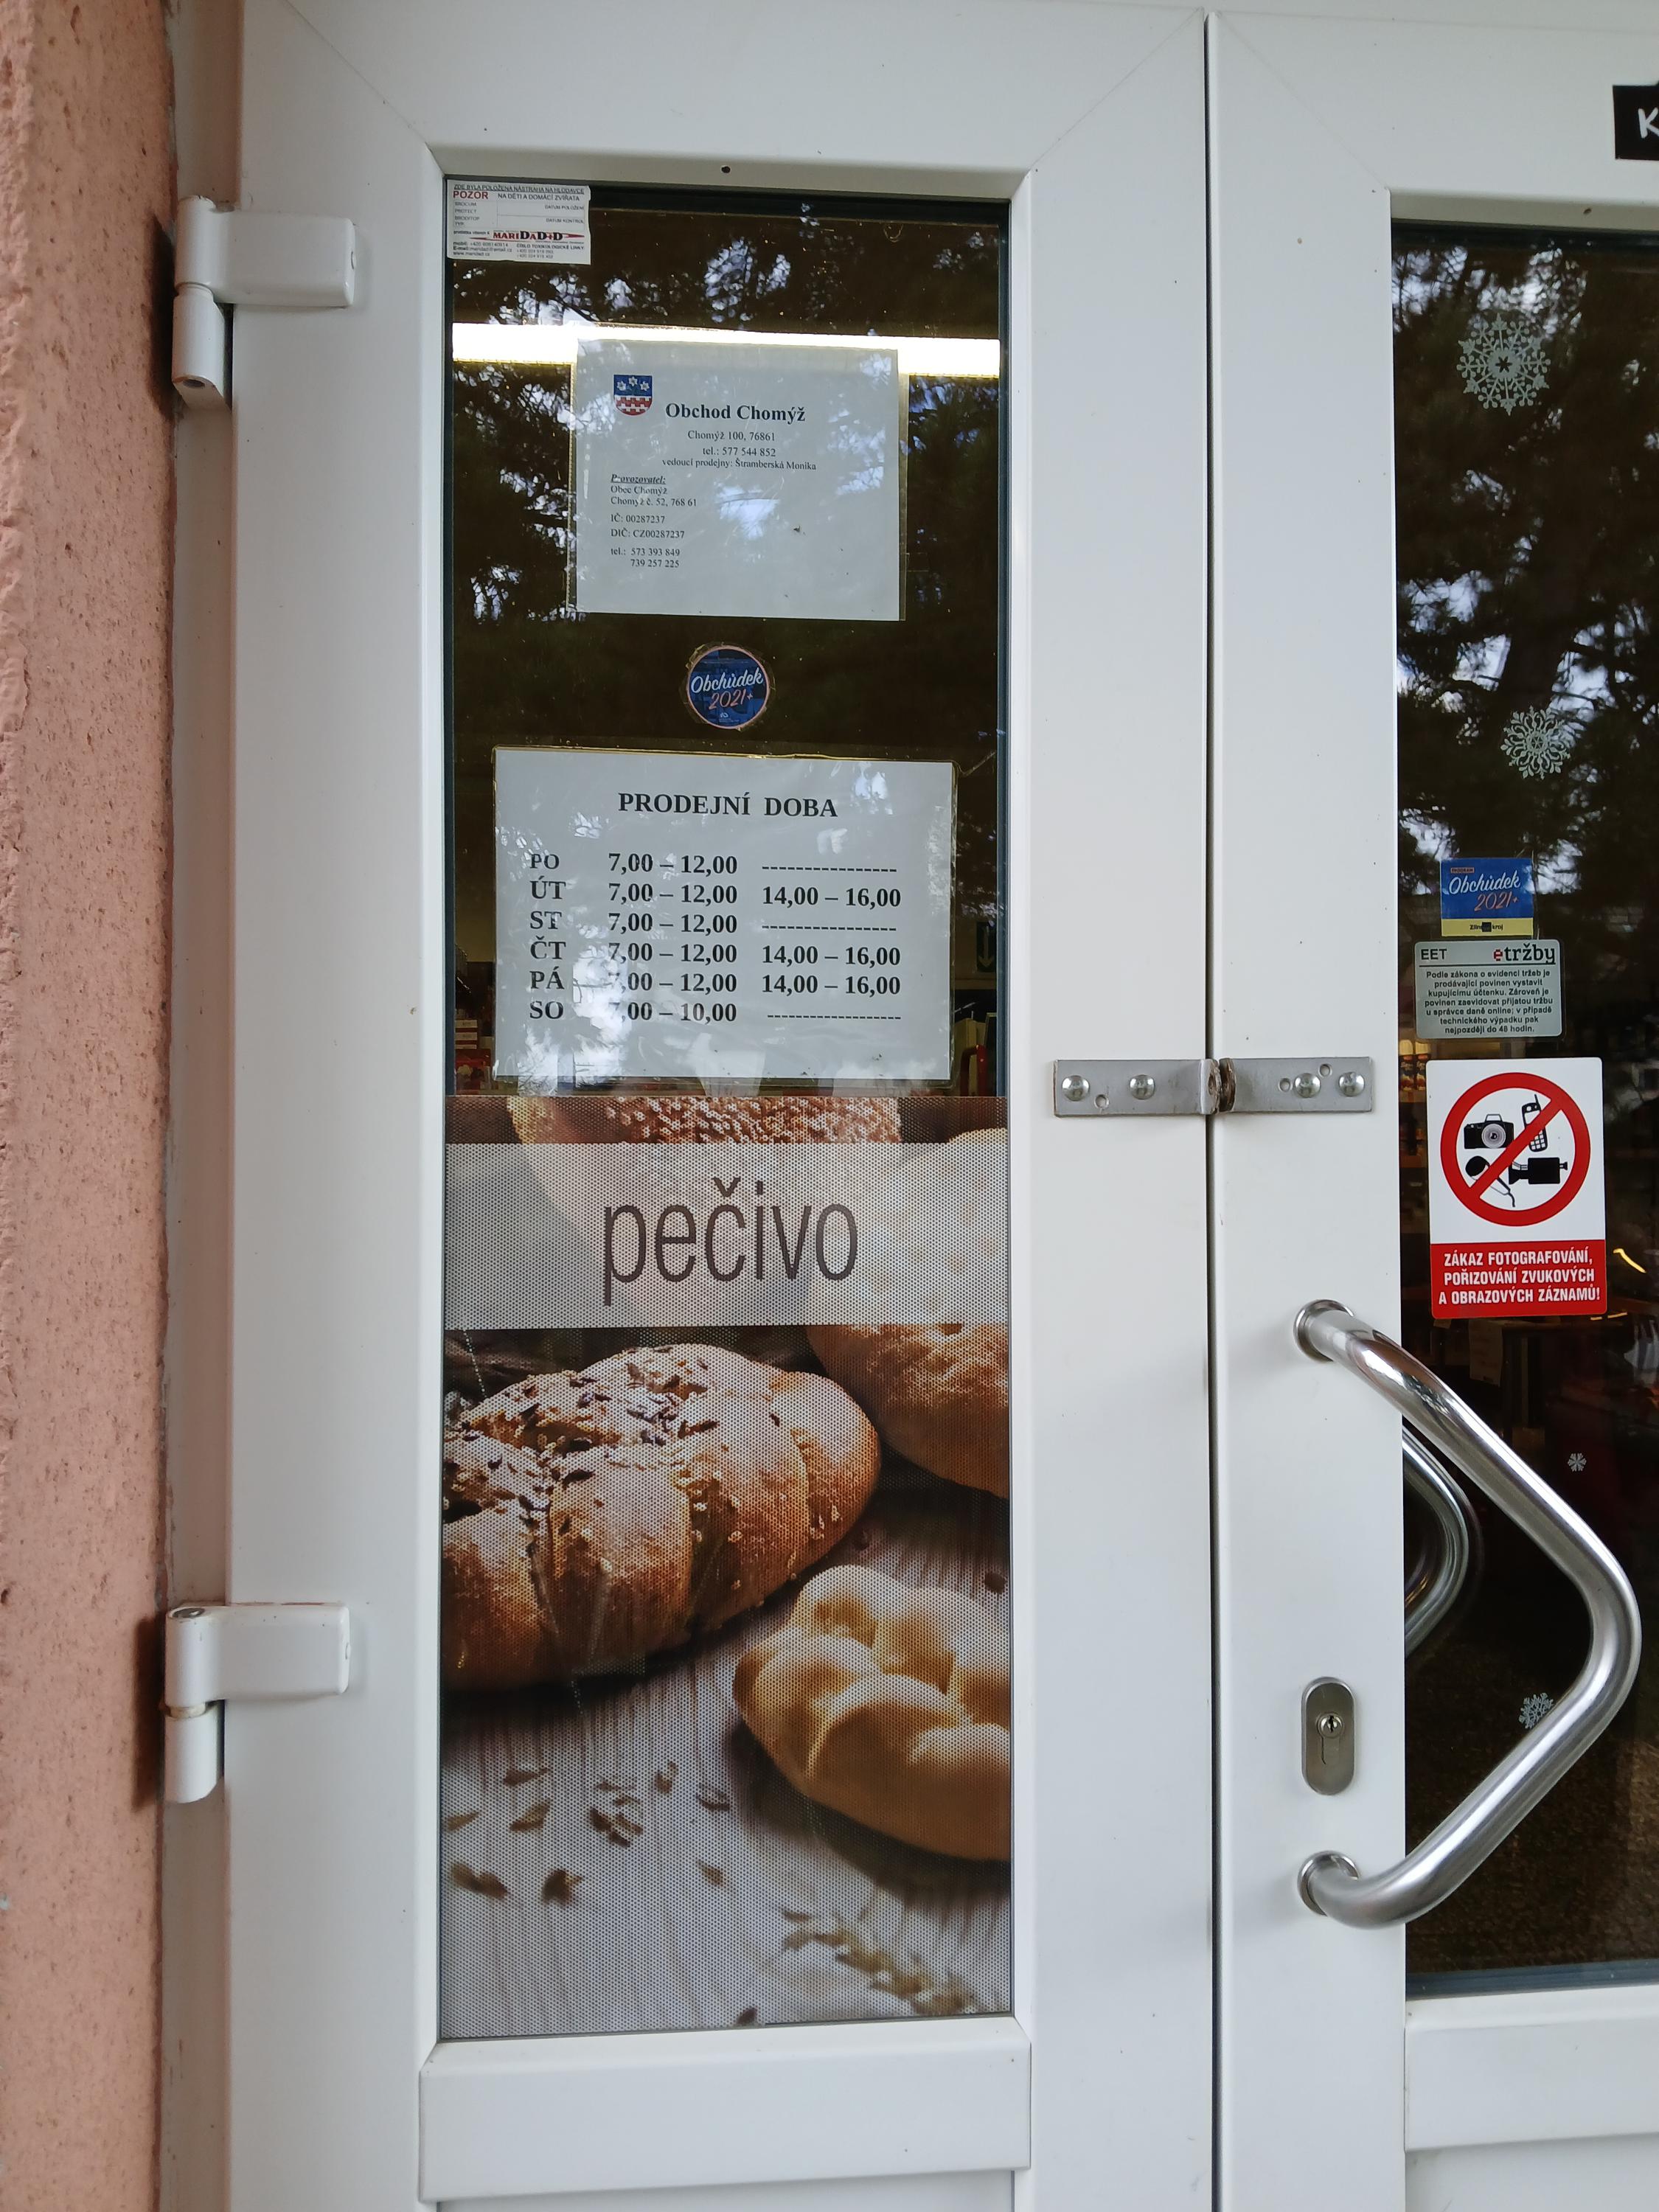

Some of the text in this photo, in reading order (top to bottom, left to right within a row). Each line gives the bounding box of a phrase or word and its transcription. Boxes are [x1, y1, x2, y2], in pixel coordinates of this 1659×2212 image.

[453, 191, 488, 199] POZOR
[666, 403, 806, 425] Obchod Chomýž
[687, 430, 776, 442] Chomýž 100, 76861
[703, 447, 776, 457] tel.: 577 544 852
[662, 457, 816, 470] vedoucí prodejny: Štramberská Monika
[611, 485, 633, 495] Obec
[655, 498, 668, 508] 52,
[671, 498, 686, 507] 768
[687, 498, 697, 507] 61
[611, 512, 665, 524] IČ: 00287237
[611, 528, 685, 539] DIČ: CZ00287237
[611, 547, 680, 557] tel.: 573 393 849
[630, 559, 680, 568] 739 257 225
[691, 667, 763, 693] Obchůdek
[618, 792, 838, 817] PRODEJNÍ DOBA
[529, 853, 560, 870] PO
[608, 852, 653, 873] 7,00
[680, 855, 737, 877] 12,00
[1449, 871, 1520, 895] Obchůdek
[529, 876, 566, 900] ÚT
[608, 882, 653, 903] 7,00
[680, 884, 737, 906] 12,00
[762, 886, 818, 908] 14,00
[845, 888, 901, 909] 16,00
[529, 911, 562, 930] ST
[608, 912, 653, 933] 7,00
[680, 914, 737, 935] 12,00
[529, 936, 566, 961] ČT
[608, 941, 653, 962] 7,00
[680, 943, 737, 964] 12,00
[762, 945, 818, 967] 14,00
[845, 947, 901, 967] 16,00
[1421, 943, 1555, 964] EET etržby
[1488, 970, 1520, 978] evidenci
[529, 965, 565, 990] PÁ
[680, 973, 737, 994] 12,00
[762, 975, 818, 996] 14,00
[845, 976, 901, 997] 16,00
[1434, 979, 1543, 988] prodávající povinen vystavit
[1428, 990, 1471, 998] kupujícímu
[1473, 988, 1506, 996] účtenku.
[1501, 998, 1531, 1006] přijatou
[529, 1001, 565, 1020] SO
[680, 1003, 737, 1023] 10,00
[1433, 1008, 1464, 1017] správce
[1487, 1007, 1514, 1015] online;
[1523, 1006, 1552, 1015] případě
[1490, 1017, 1523, 1026] výpadku
[1525, 1016, 1538, 1025] pak
[1445, 1026, 1485, 1035] nejpozději
[603, 1177, 858, 1306] pečivo
[1444, 1246, 1593, 1267] ZÁKAZ FOTOGRAFOVÁNÍ,
[1444, 1265, 1595, 1286] POŘIZOVÁNÍ ZVUKOVÝCH
[1439, 1284, 1600, 1304] A OBRAZOVÝCH ZÁZNAMŮ!
